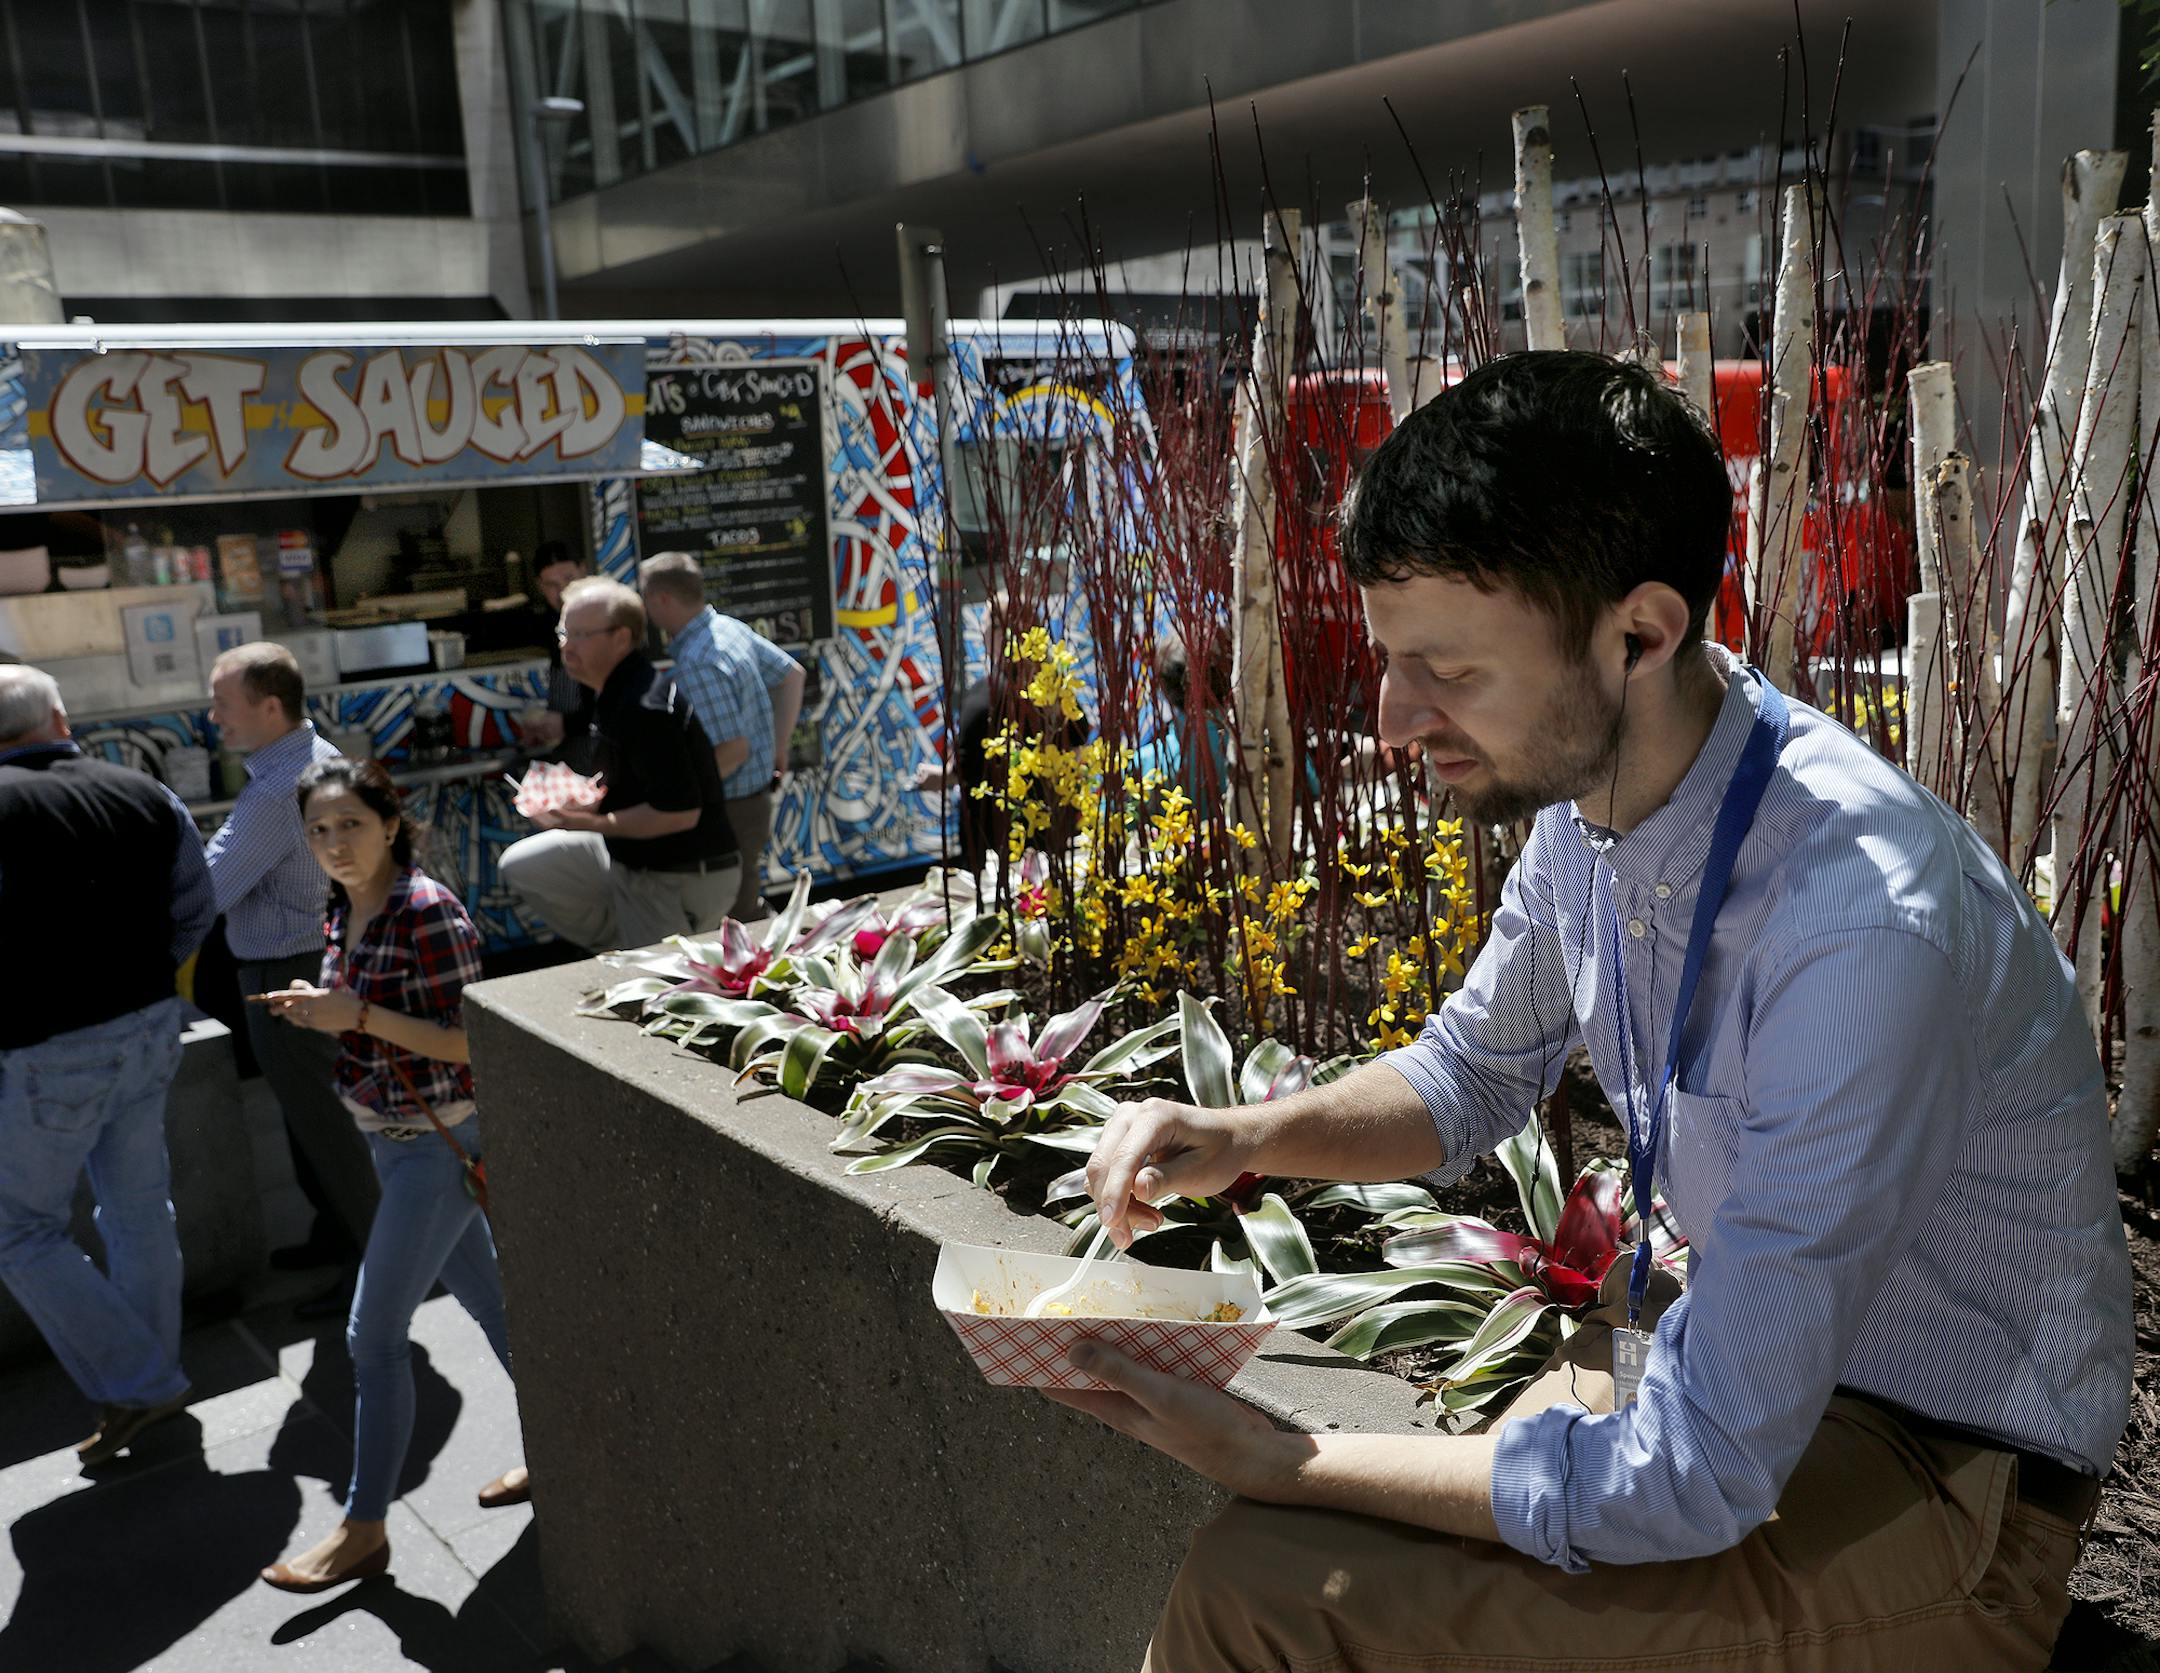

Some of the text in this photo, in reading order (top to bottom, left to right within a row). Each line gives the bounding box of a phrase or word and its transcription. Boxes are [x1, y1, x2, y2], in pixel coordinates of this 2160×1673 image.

[48, 346, 626, 489] GET SAUCED
[680, 412, 775, 434] SANDWICHES
[708, 527, 760, 546] TACOS
[1619, 1340, 1637, 1367] H
